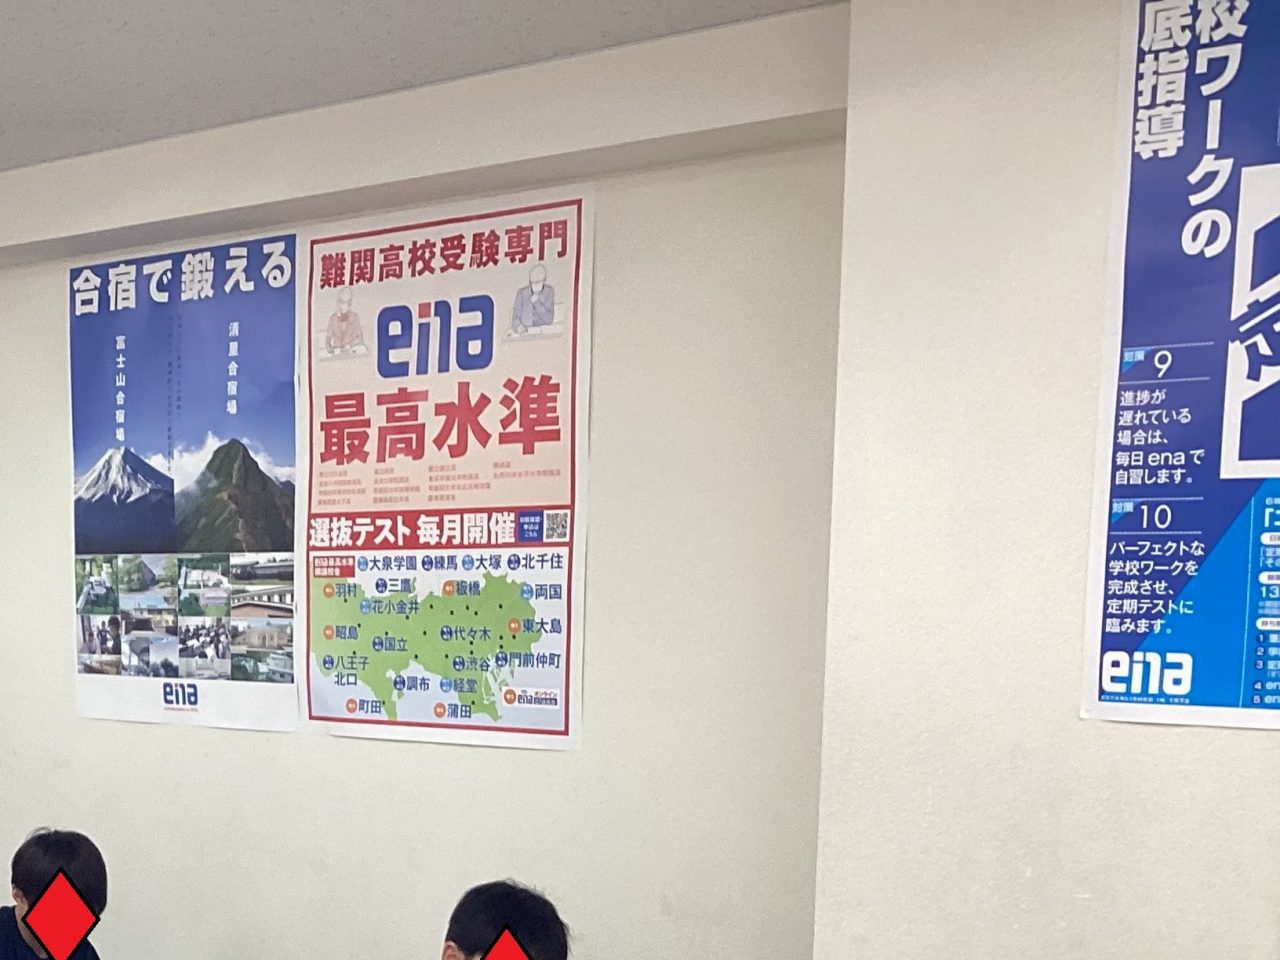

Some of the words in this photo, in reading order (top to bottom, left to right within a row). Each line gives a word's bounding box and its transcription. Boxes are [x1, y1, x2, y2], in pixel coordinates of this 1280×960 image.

[320, 219, 568, 289] 難関高校受験専門
[73, 241, 292, 316] 合宿で鍛える
[377, 294, 494, 380] ena
[1154, 350, 1172, 378] 9
[1120, 389, 1167, 406] 進捗が
[320, 374, 561, 465] 最高水準
[1118, 408, 1191, 426] 遅れている
[1116, 429, 1168, 445] 場合は、
[1115, 468, 1193, 485] 自習します。
[1141, 504, 1172, 529] 10
[1110, 541, 1205, 556] パーフェクトな
[370, 555, 417, 571] 大泉学園
[434, 555, 458, 570] 練馬
[476, 554, 502, 570] 大塚
[522, 553, 563, 570] 北千住
[1108, 561, 1199, 576] 学校ワークを
[335, 583, 357, 598] 羽村
[456, 580, 481, 596] 板橋
[535, 584, 562, 600] 両国
[1107, 579, 1175, 595] 完成させ、
[372, 598, 419, 614] 花小金井
[1106, 599, 1194, 614] 定期テストに
[335, 625, 359, 640] 昭島
[454, 626, 491, 641] 代々木
[523, 618, 562, 634] 東大島
[1105, 618, 1172, 634] 臨みます。
[384, 636, 408, 652] 国立
[335, 655, 369, 671] 八王子
[466, 656, 491, 672] 渋谷
[509, 652, 561, 669] 門前仲町
[334, 672, 358, 686] 北口
[1101, 650, 1193, 696] ena
[406, 676, 430, 691] 調布
[453, 678, 478, 693] 経堂
[163, 682, 198, 705] ena
[359, 699, 381, 714] 町田
[447, 703, 472, 719] 蒲田
